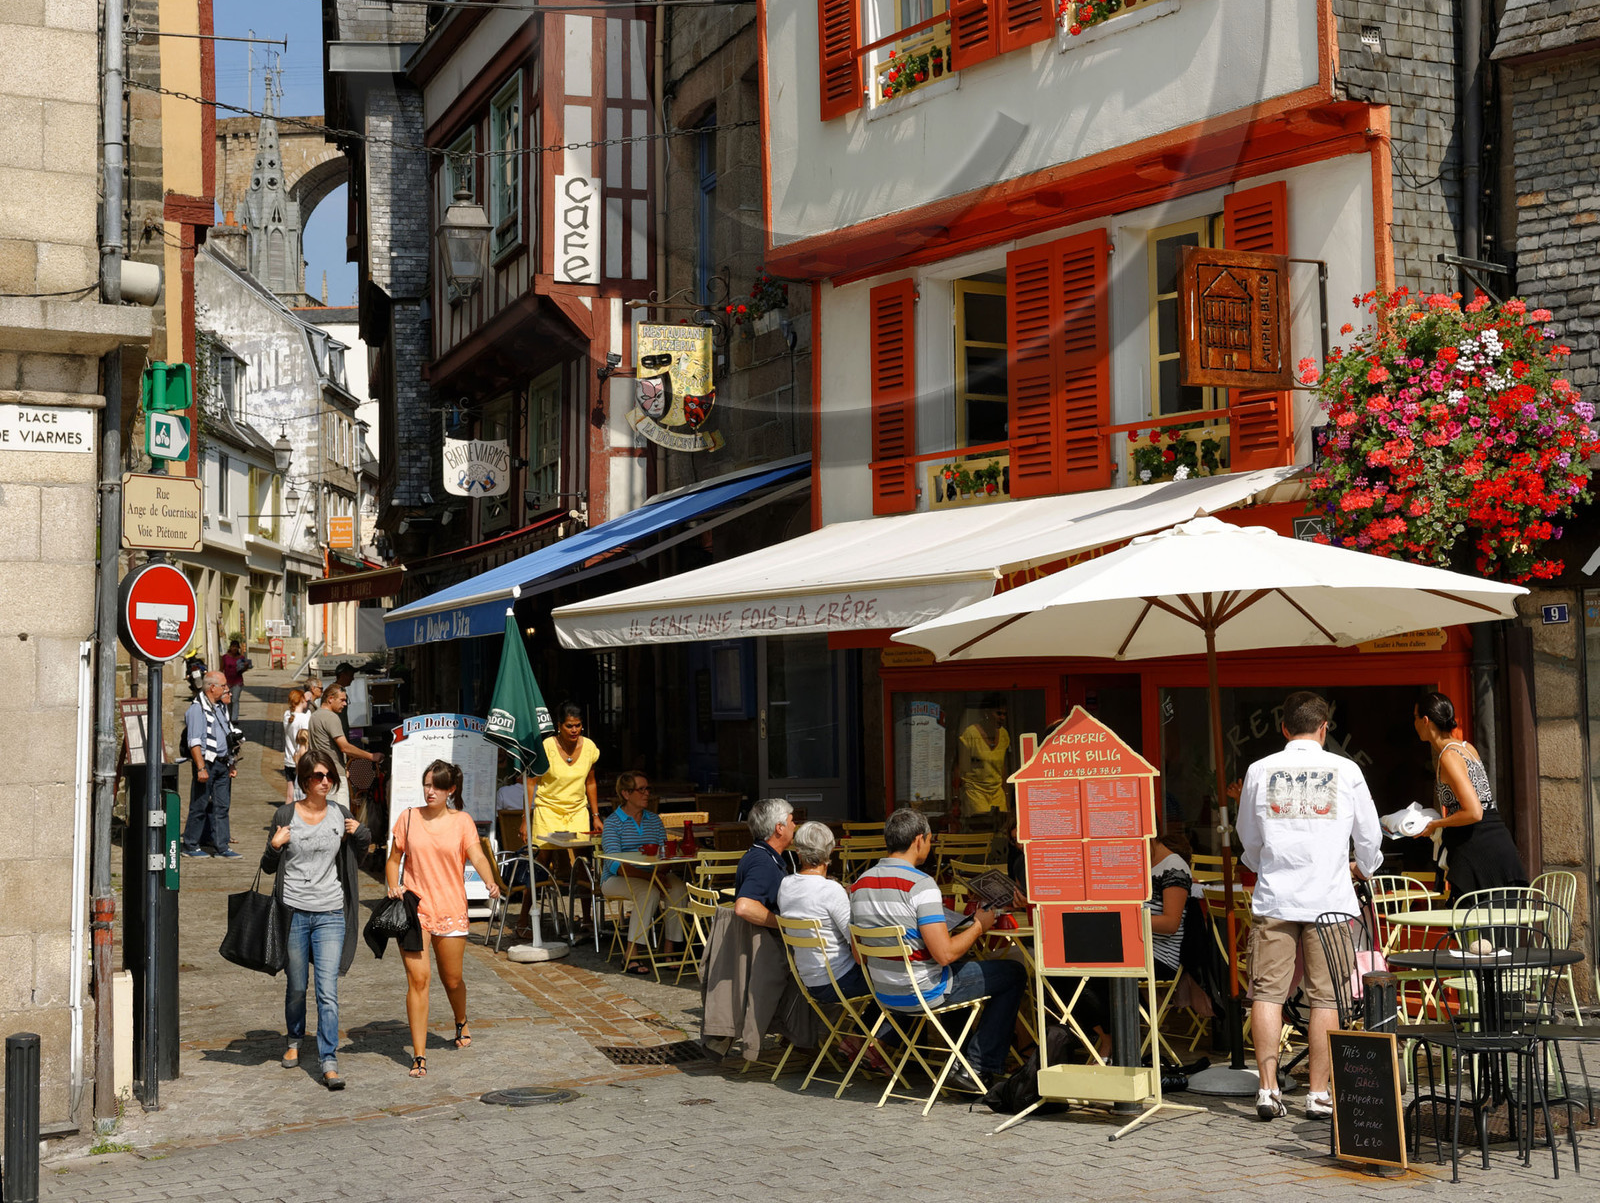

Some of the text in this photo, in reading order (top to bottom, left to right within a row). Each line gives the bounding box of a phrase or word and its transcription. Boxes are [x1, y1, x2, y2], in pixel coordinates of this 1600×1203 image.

[1259, 275, 1271, 364] ATIPIK BILIG
[643, 326, 706, 341] RESTAURANT
[652, 339, 697, 352] PIZZERIA
[18, 412, 58, 424] PLACE
[642, 421, 656, 438] LA
[19, 430, 82, 445] VIARMES
[156, 487, 170, 499] Rue
[127, 502, 198, 519] Ange de Guernisac
[137, 524, 188, 540] Voie Piétonne
[629, 594, 878, 638] IL ETAIT UNE FOIS LA CRÊPE
[1550, 607, 1559, 621] 9
[413, 610, 471, 644] La Dolce Vita
[406, 715, 486, 733] La Dolce Vita
[1052, 731, 1108, 746] CREPERIE
[1042, 747, 1121, 765] ATIPIK BILIG
[1043, 768, 1055, 778] Tél
[1347, 1094, 1384, 1106] EMPORTER
[1352, 1107, 1365, 1117] OU
